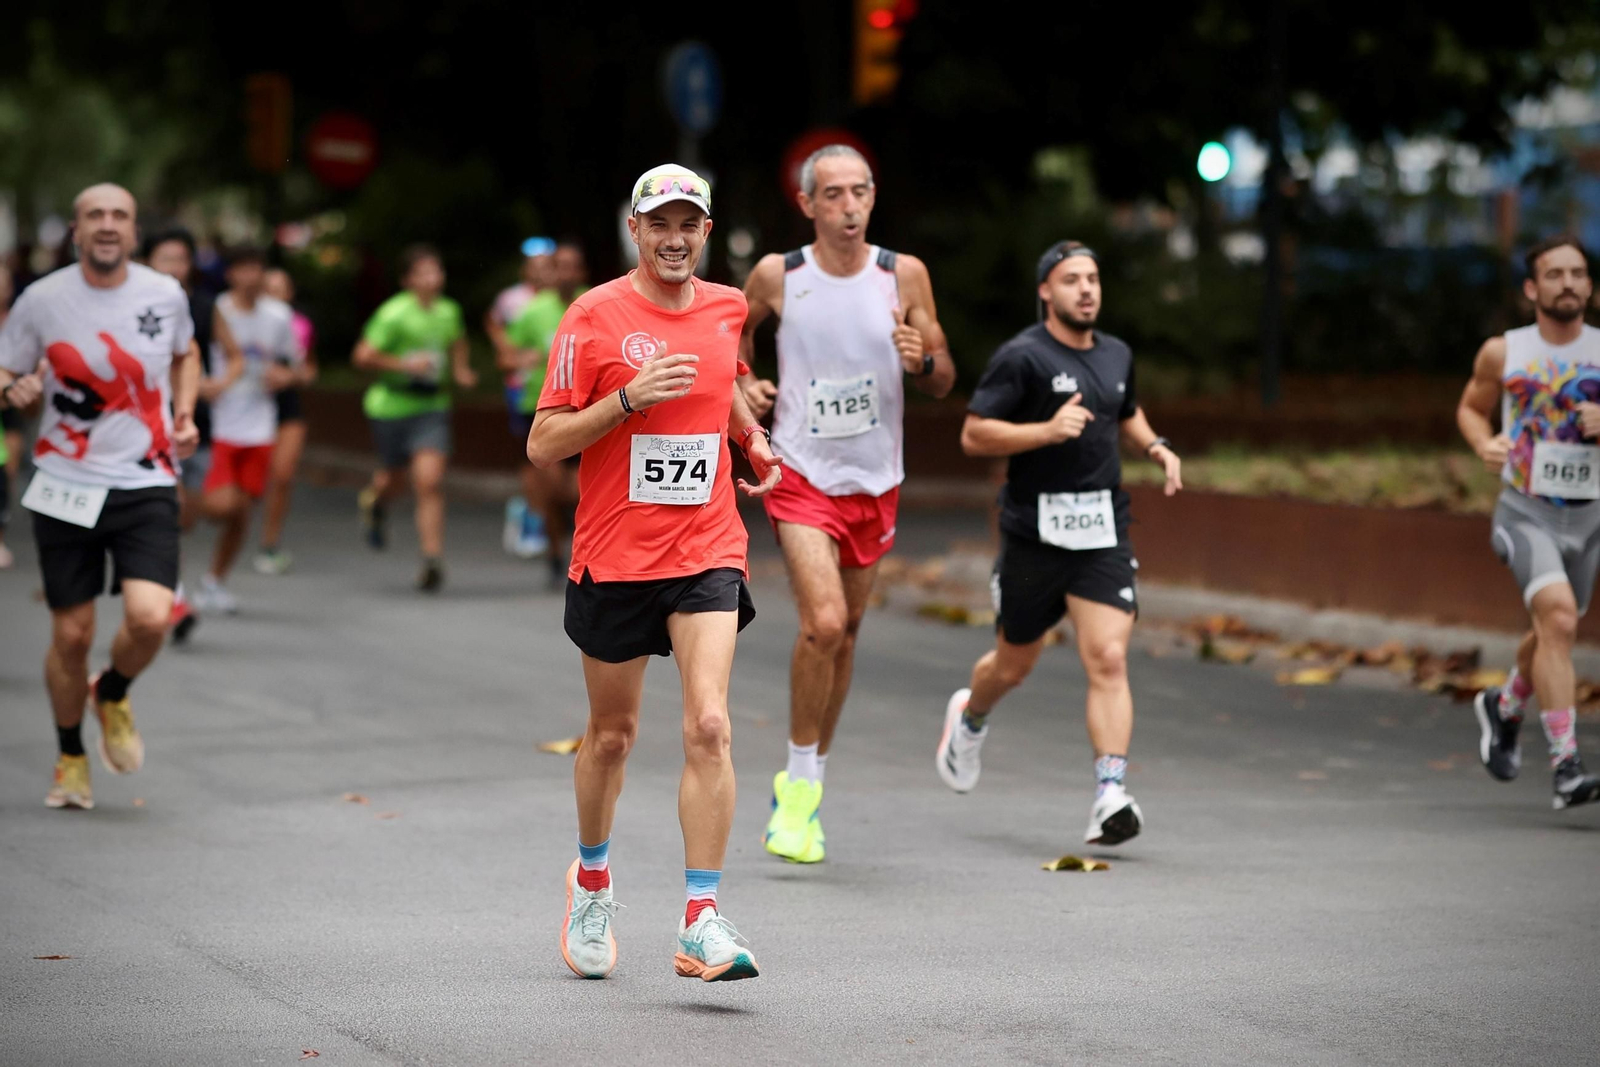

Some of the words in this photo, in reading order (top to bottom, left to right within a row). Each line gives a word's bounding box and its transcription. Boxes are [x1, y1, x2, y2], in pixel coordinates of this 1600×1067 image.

[815, 394, 870, 415] 1125
[644, 458, 707, 484] 574
[1050, 513, 1104, 530] 1204
